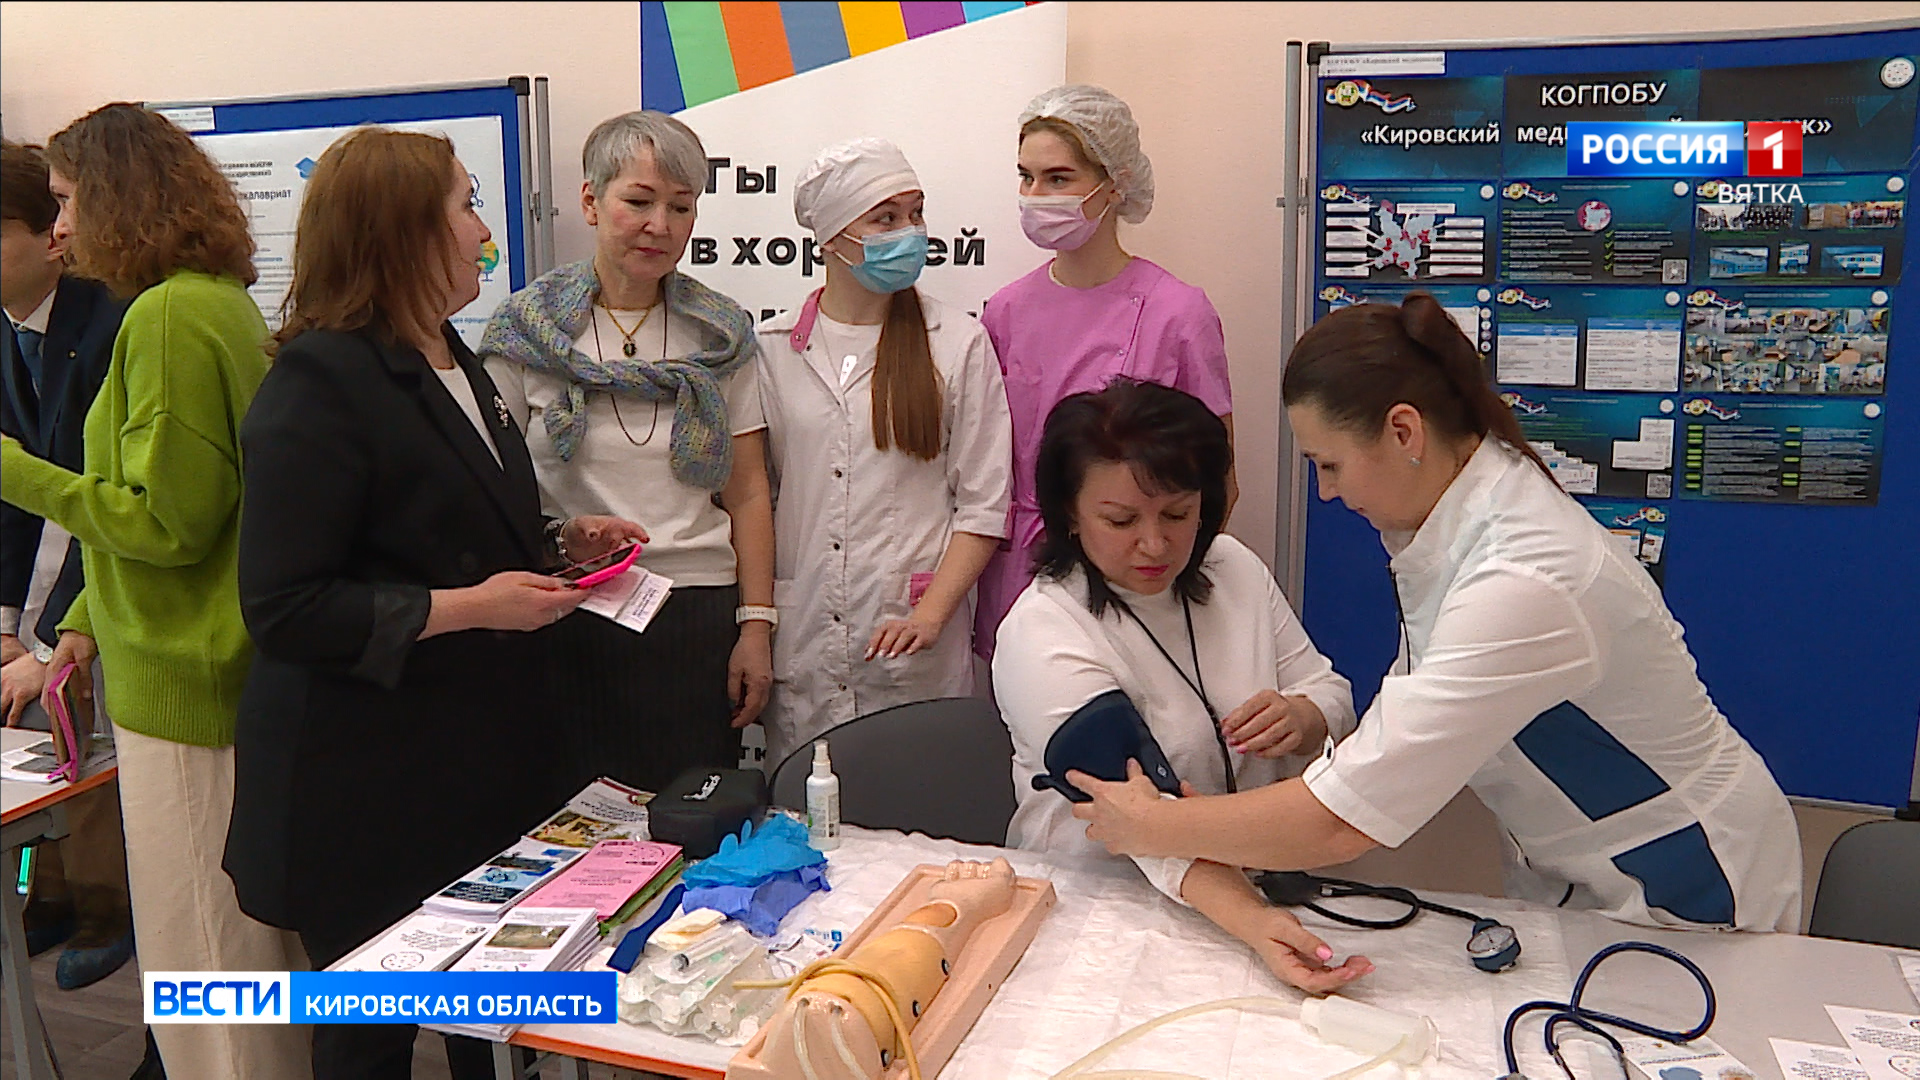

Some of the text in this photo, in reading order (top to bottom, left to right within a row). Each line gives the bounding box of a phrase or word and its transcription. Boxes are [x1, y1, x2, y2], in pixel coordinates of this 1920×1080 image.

[1541, 82, 1667, 106] КОГПОБУ
[1361, 121, 1500, 149] «Кировский
[703, 157, 777, 194] Ты
[691, 227, 986, 276] в хорей
